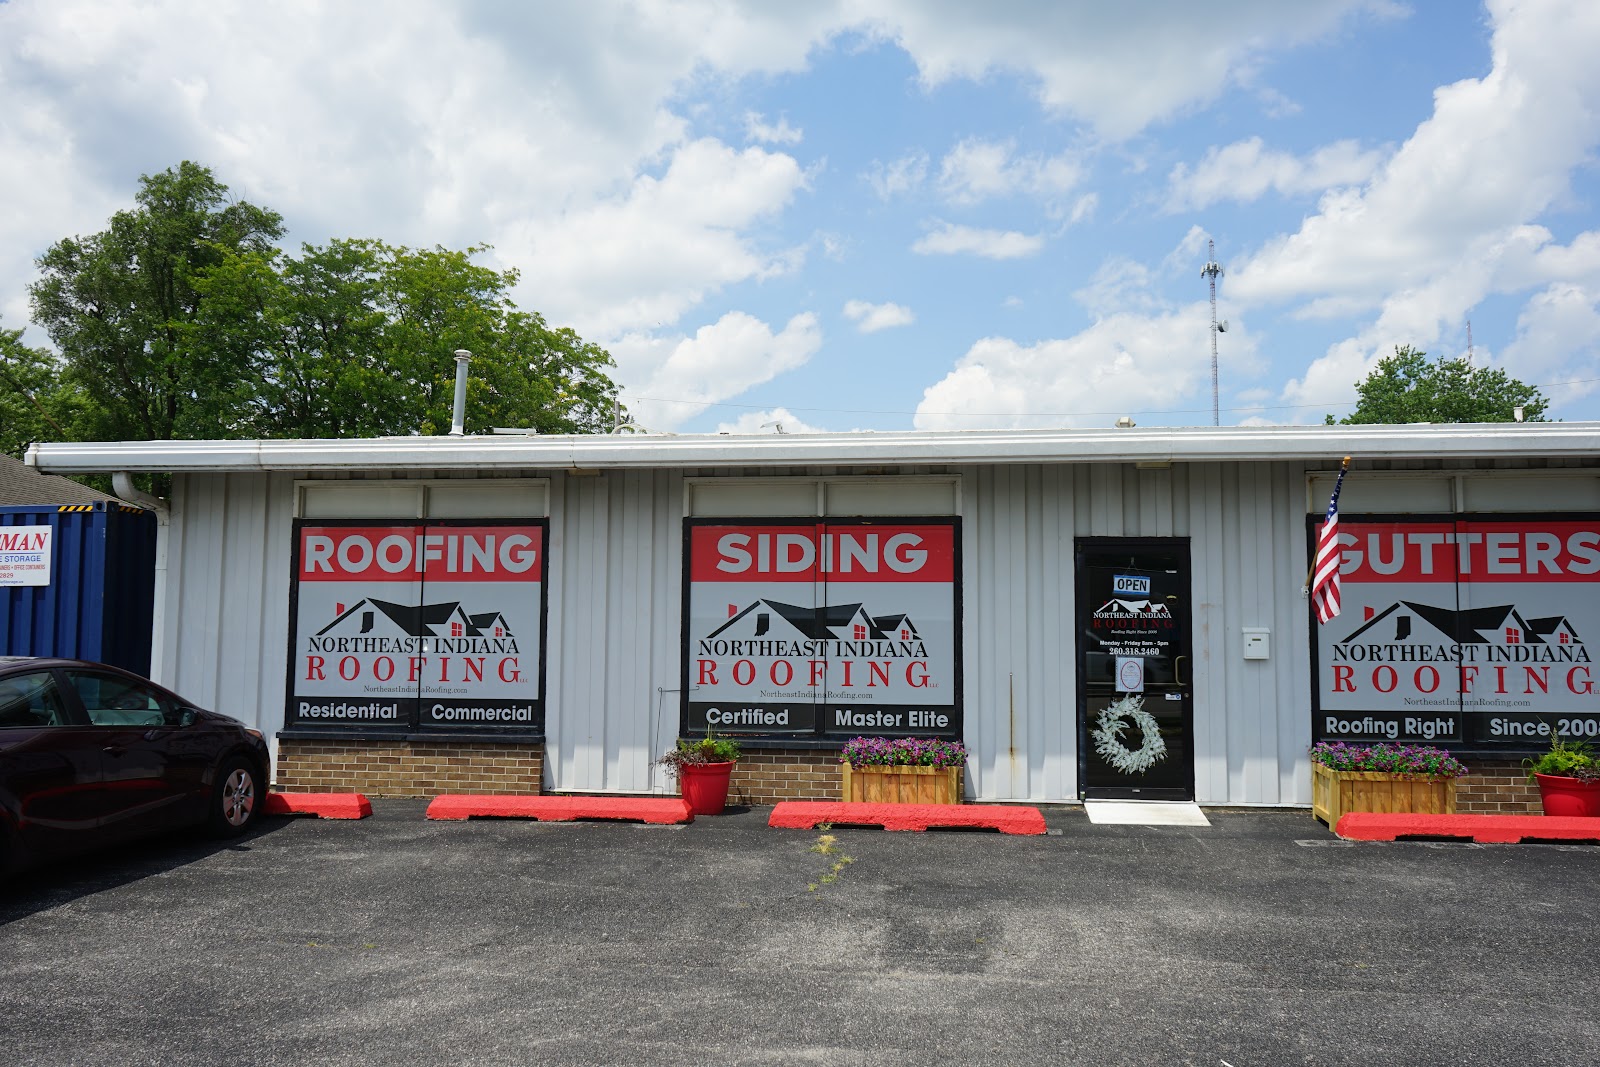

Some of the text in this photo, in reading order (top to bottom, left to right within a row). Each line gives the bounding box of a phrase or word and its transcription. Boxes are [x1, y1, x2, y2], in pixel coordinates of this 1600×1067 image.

[0, 533, 48, 550] MAN
[304, 534, 537, 573] ROOFING
[716, 532, 928, 574] SIDING
[1118, 578, 1147, 591] OPEN
[1093, 619, 1172, 628] ROOFING
[308, 637, 520, 654] NORTHEAST INDIANA
[698, 639, 929, 658] NORTHEAST INDIANA
[1109, 647, 1160, 655] 260.318.2460
[1332, 644, 1592, 663] NORTHEAST INDIANA
[305, 656, 521, 683] ROOFING
[696, 659, 931, 688] ROOFING
[363, 685, 468, 694] NortheastIndianaRoofing.com
[1331, 665, 1595, 695] ROOFING
[760, 690, 873, 700] NortheastIndianaRoofing.com
[1404, 698, 1531, 708] NortheastIndianaRoofing.com
[299, 702, 532, 721] Residential Commercial
[706, 707, 949, 727] Certified Master Elite
[1325, 716, 1600, 739] Roofing Right Since 200
